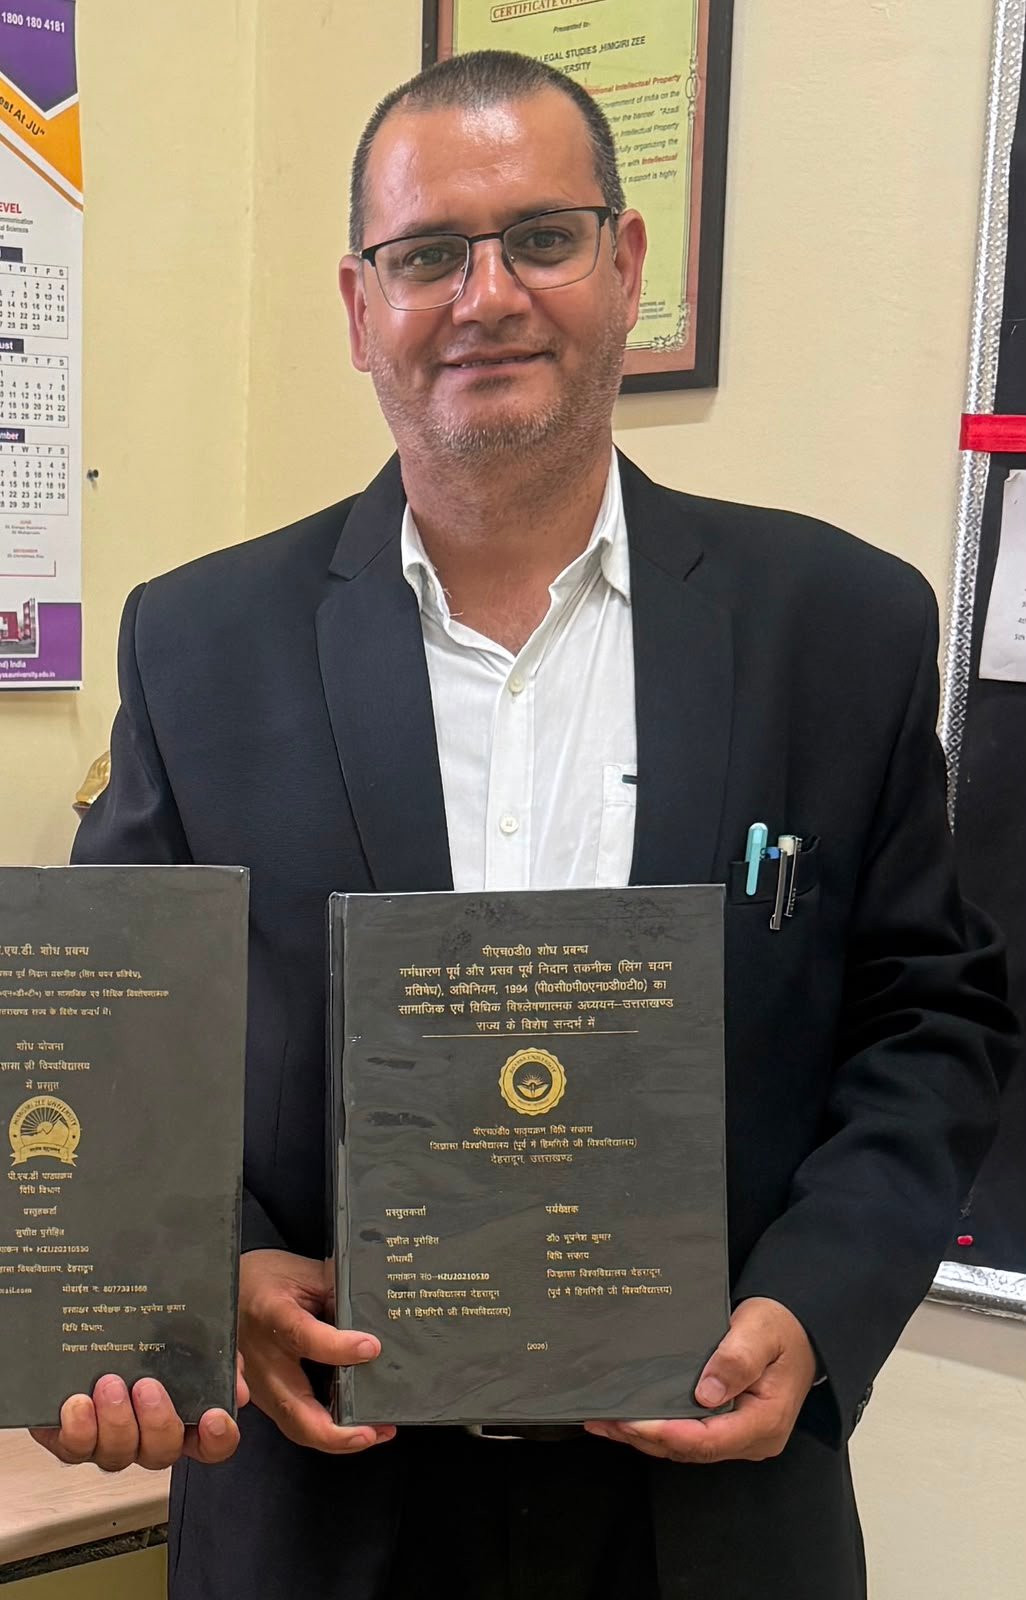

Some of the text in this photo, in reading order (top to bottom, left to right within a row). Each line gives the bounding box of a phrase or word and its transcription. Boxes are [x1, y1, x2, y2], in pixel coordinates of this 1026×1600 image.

[1, 12, 66, 33] 1800 180 4181
[565, 44, 598, 58] STUDIES
[631, 36, 646, 46] ZEE
[559, 61, 592, 74] VERSITY
[13, 110, 26, 124] At
[0, 202, 22, 214] EVEL
[446, 963, 460, 980] पूर्व
[465, 962, 484, 976] और
[490, 965, 514, 977] प्रसव
[518, 962, 534, 978] पूर्व
[538, 961, 568, 974] निदान
[573, 960, 612, 974] तकनीक
[648, 961, 673, 972] चयन
[504, 984, 529, 994] 1994
[652, 980, 667, 990] का
[398, 1002, 446, 1015] सामाजिक
[476, 1021, 500, 1031] राज्य
[506, 1018, 516, 1030] के
[522, 1017, 549, 1030] विशेष
